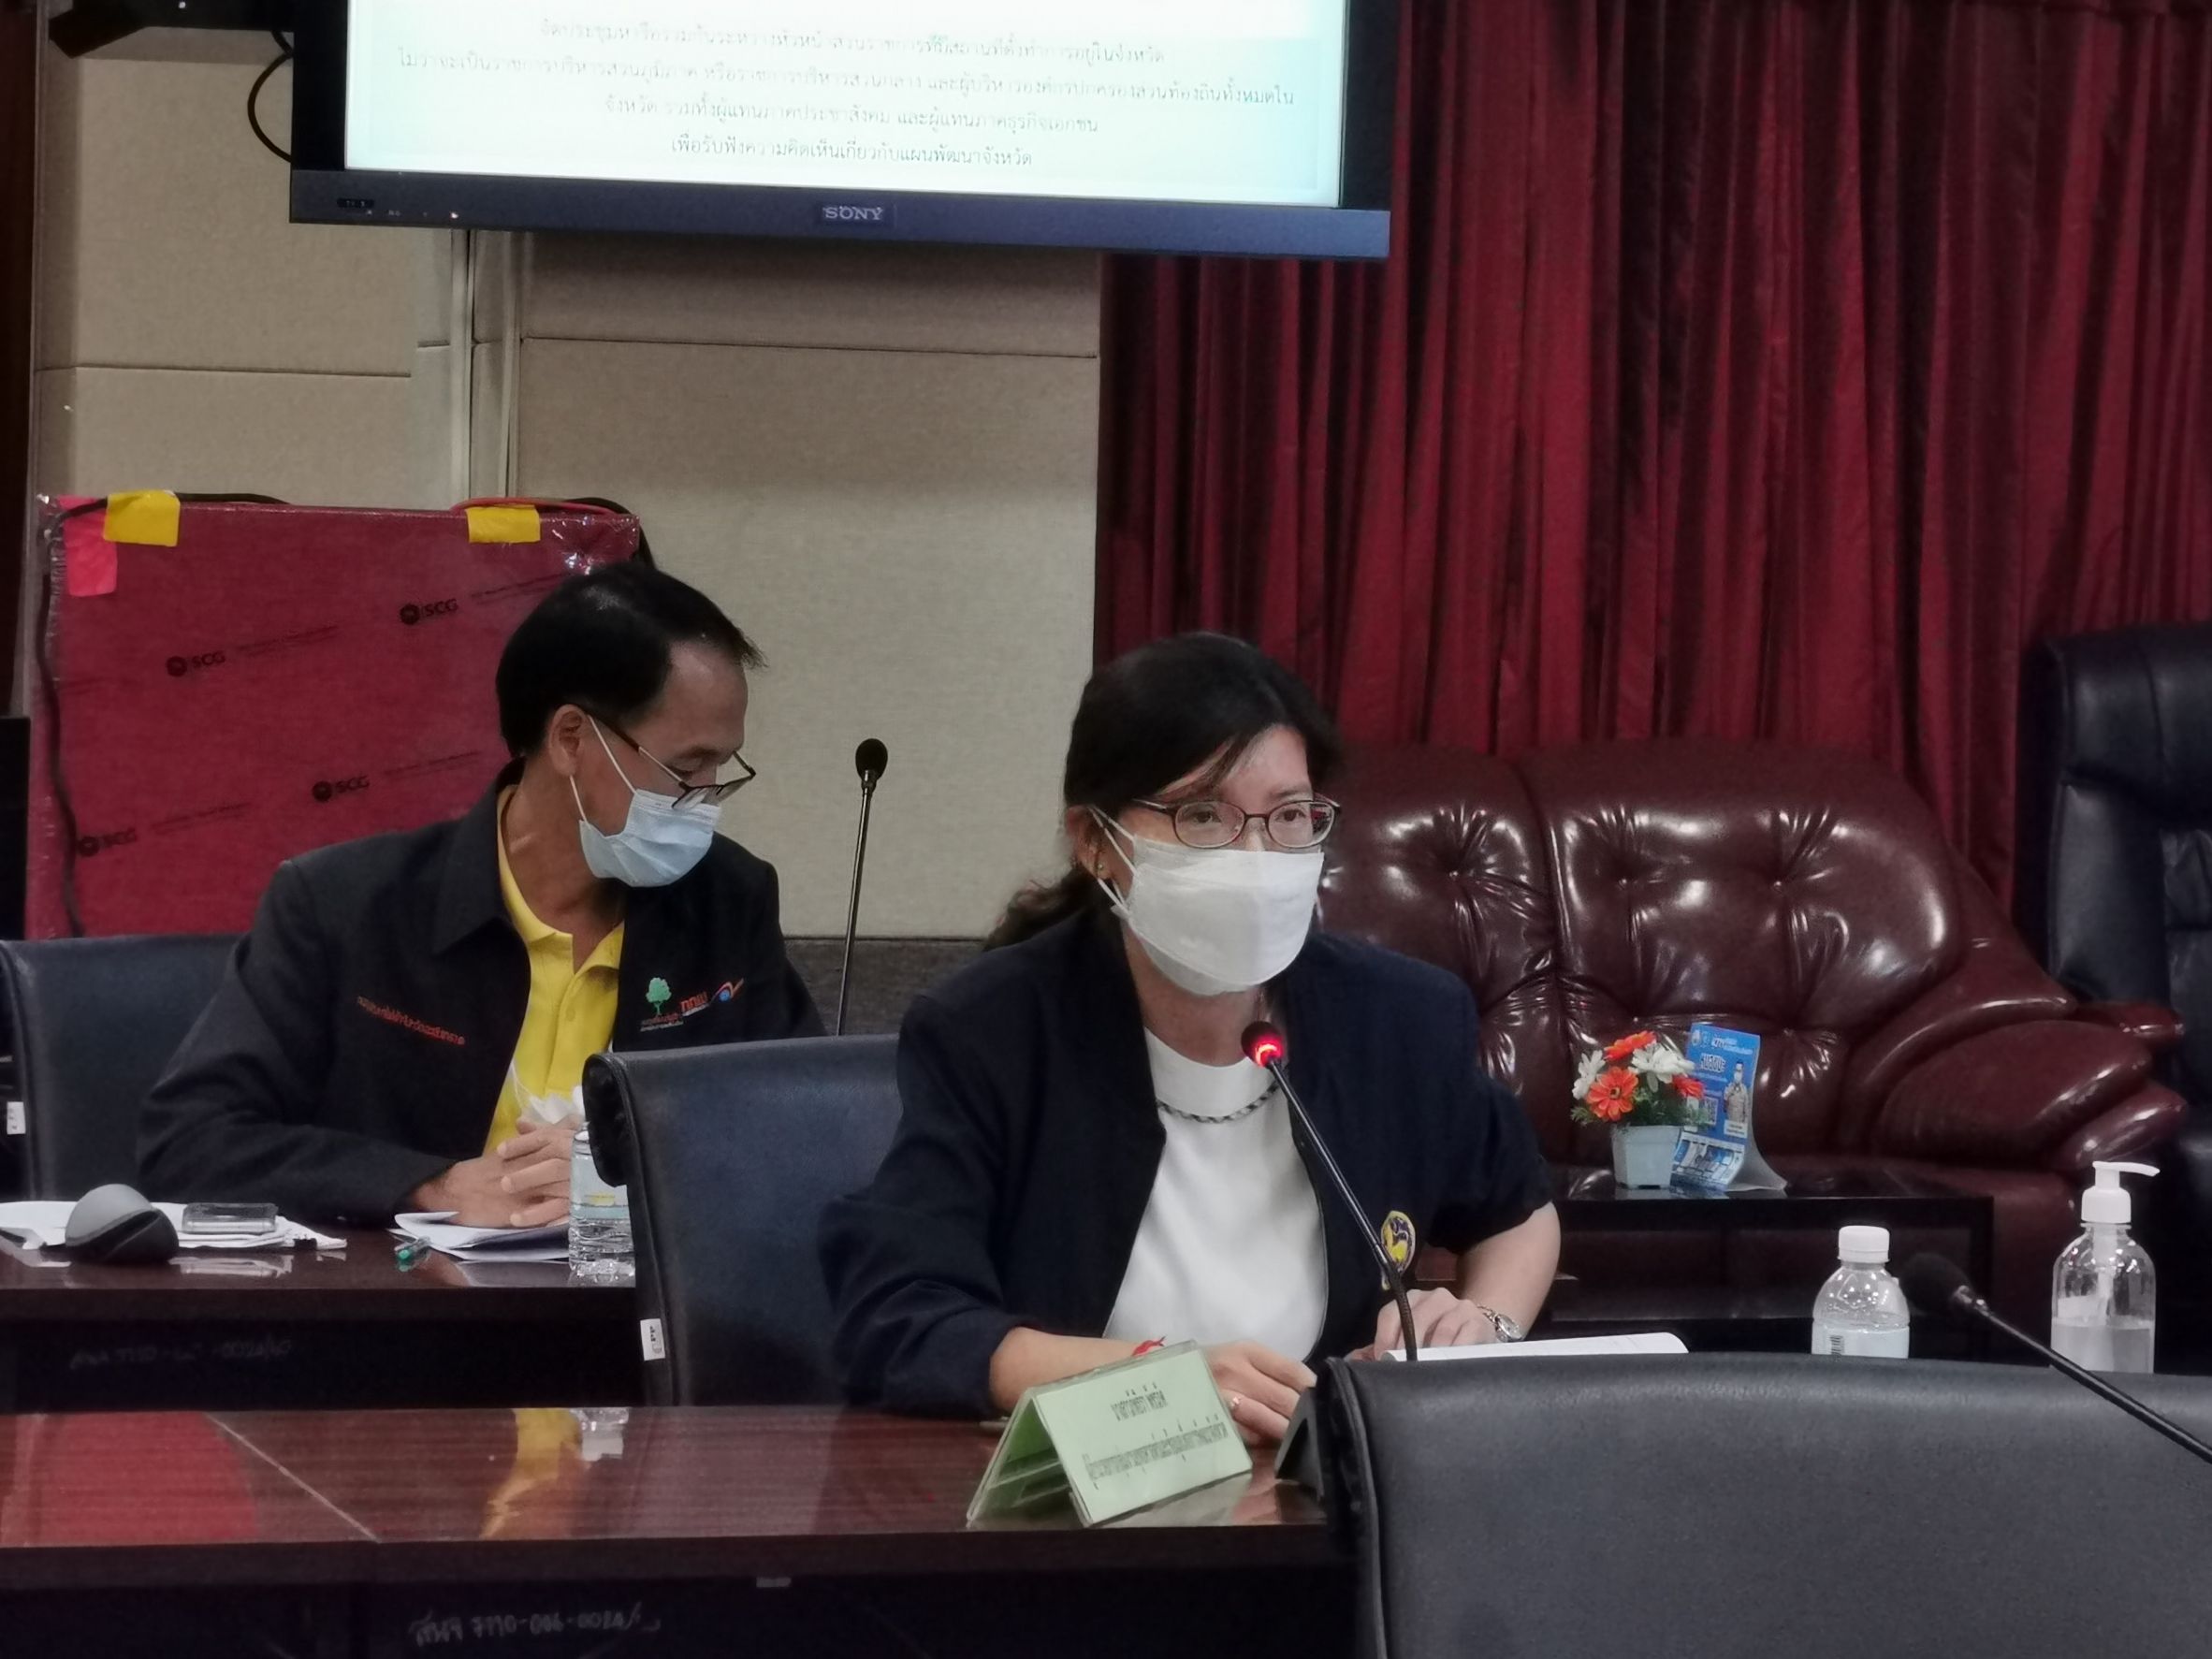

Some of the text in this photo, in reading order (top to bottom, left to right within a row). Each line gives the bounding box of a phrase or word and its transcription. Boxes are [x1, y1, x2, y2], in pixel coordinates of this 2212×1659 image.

[671, 127, 1034, 167] เพื่อรับฟังความคิดเห็นเกี่ยวกับแผนพัฒนาจังหวัด
[824, 205, 883, 220] SONY
[424, 598, 458, 617] SCG
[334, 776, 371, 793] SCG
